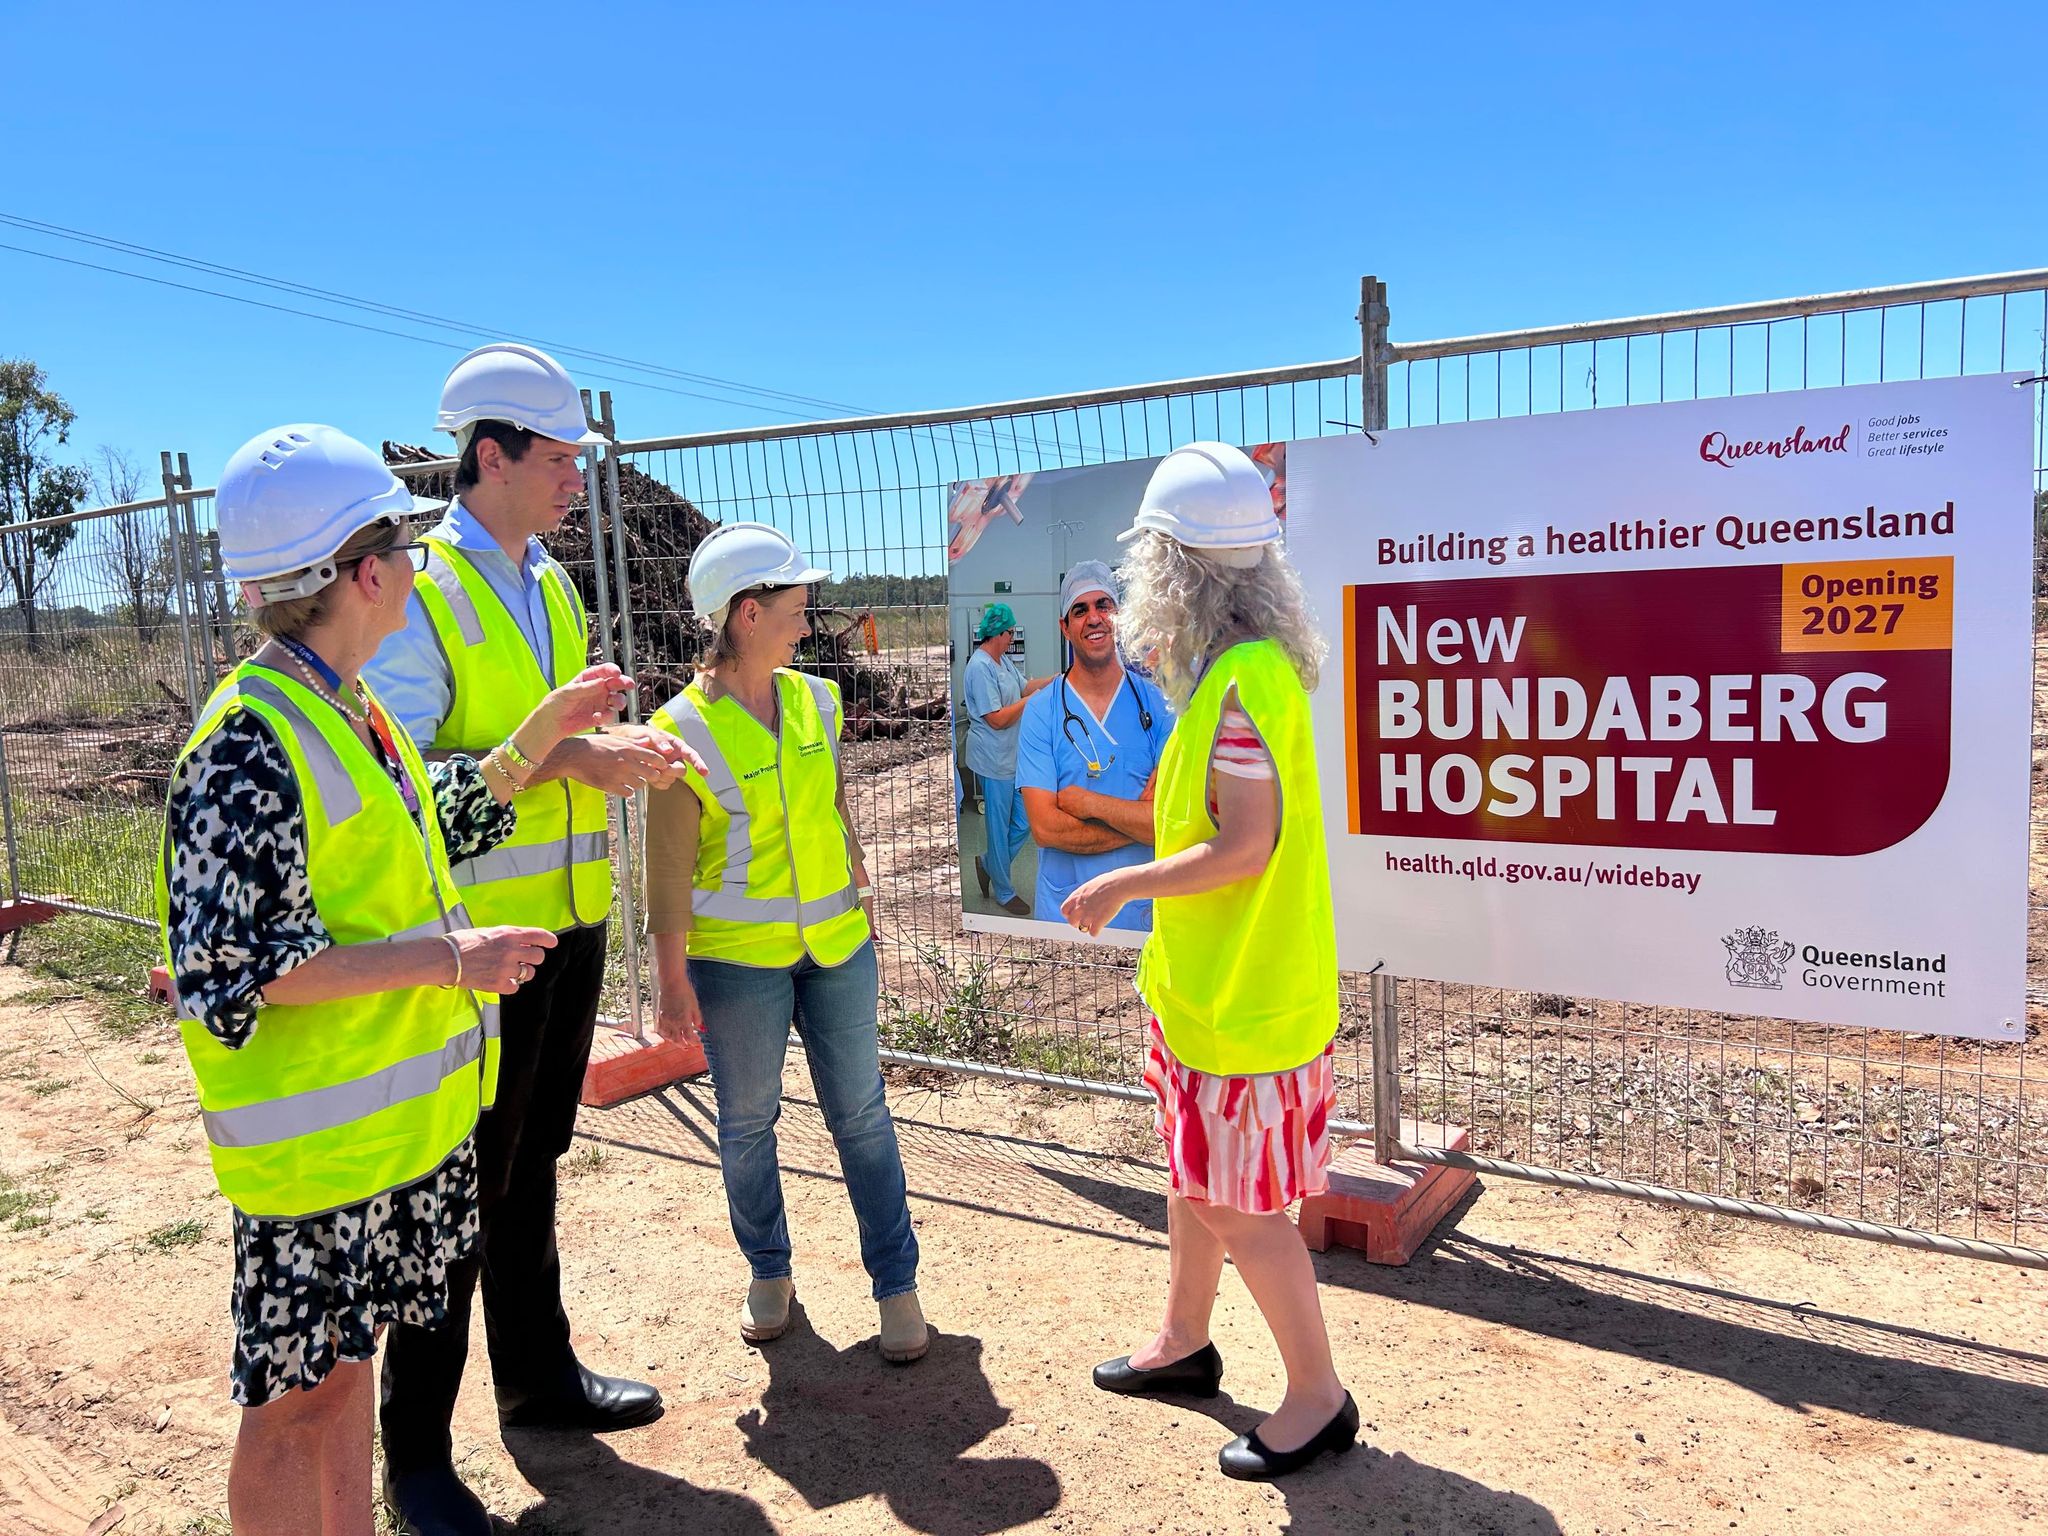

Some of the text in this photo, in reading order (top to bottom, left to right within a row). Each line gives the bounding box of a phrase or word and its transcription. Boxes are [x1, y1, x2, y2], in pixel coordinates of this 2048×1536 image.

[1868, 414, 1921, 427] Good jobs
[1868, 427, 1948, 443] Better services
[1699, 424, 1851, 468] Queensland
[1867, 442, 1945, 458] Great lifestyle
[1377, 501, 1955, 566] Building a healthier Queensland
[1800, 569, 1939, 604] Opening
[1377, 604, 1527, 666] New
[1801, 603, 1905, 636] 2027
[1378, 671, 1888, 744] BUNDABERG
[1378, 752, 1778, 826] HOSPITAL
[1385, 851, 1702, 896] health.qld.gov.au/widebay
[1802, 944, 1946, 973] Queensland
[1802, 968, 1946, 998] Government
